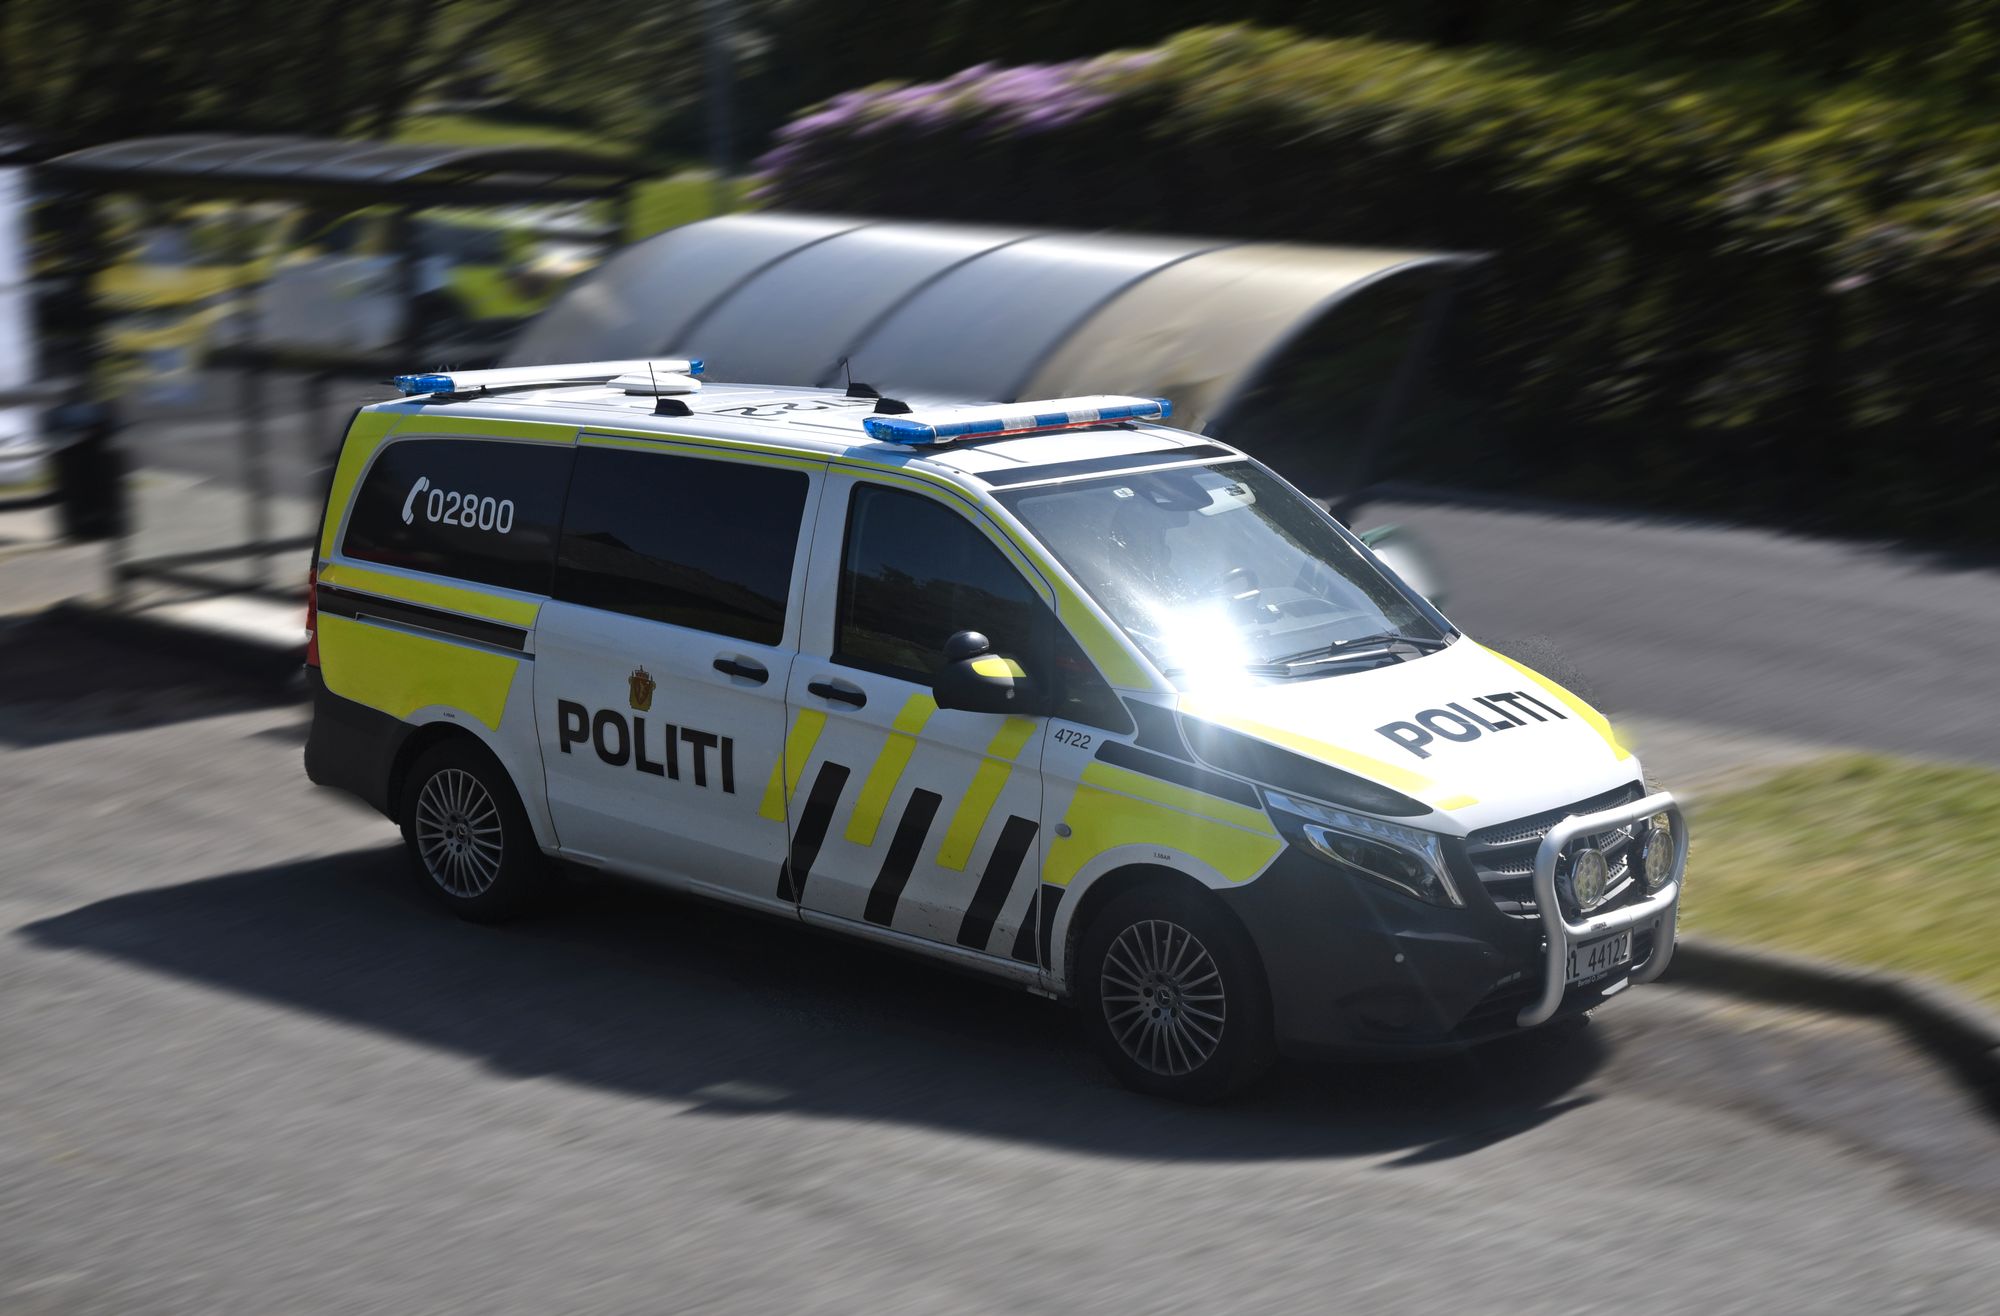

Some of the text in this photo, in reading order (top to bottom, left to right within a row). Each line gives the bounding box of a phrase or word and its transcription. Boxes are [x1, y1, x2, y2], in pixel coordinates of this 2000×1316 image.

[426, 488, 515, 534] 02800
[557, 698, 735, 794] POLITI
[1054, 728, 1092, 750] 4722
[1374, 690, 1569, 760] POLITI
[1588, 934, 1628, 972] 44122
